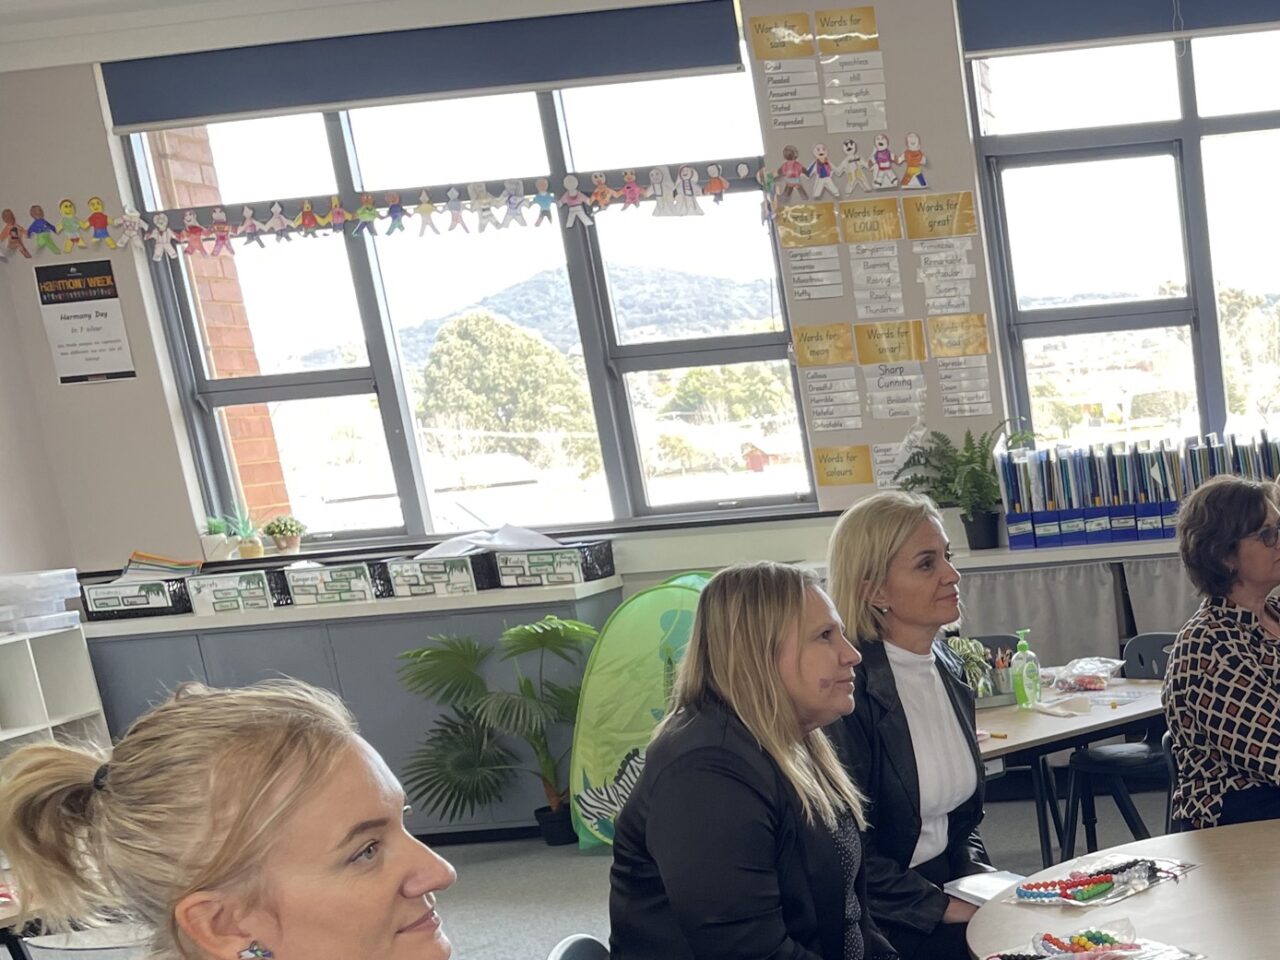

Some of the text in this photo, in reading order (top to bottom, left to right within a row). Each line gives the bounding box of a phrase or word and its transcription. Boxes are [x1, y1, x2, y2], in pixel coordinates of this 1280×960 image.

[820, 13, 862, 27] Words for
[754, 22, 779, 34] Wor
[844, 205, 885, 219] Words for
[915, 199, 959, 213] Words for
[853, 220, 879, 233] LOUD
[60, 309, 108, 321] Harmony Day
[826, 330, 838, 341] for
[866, 325, 911, 340] Words for
[878, 364, 904, 377] Sharp
[877, 377, 913, 390] Cunning
[818, 452, 857, 464] Words for
